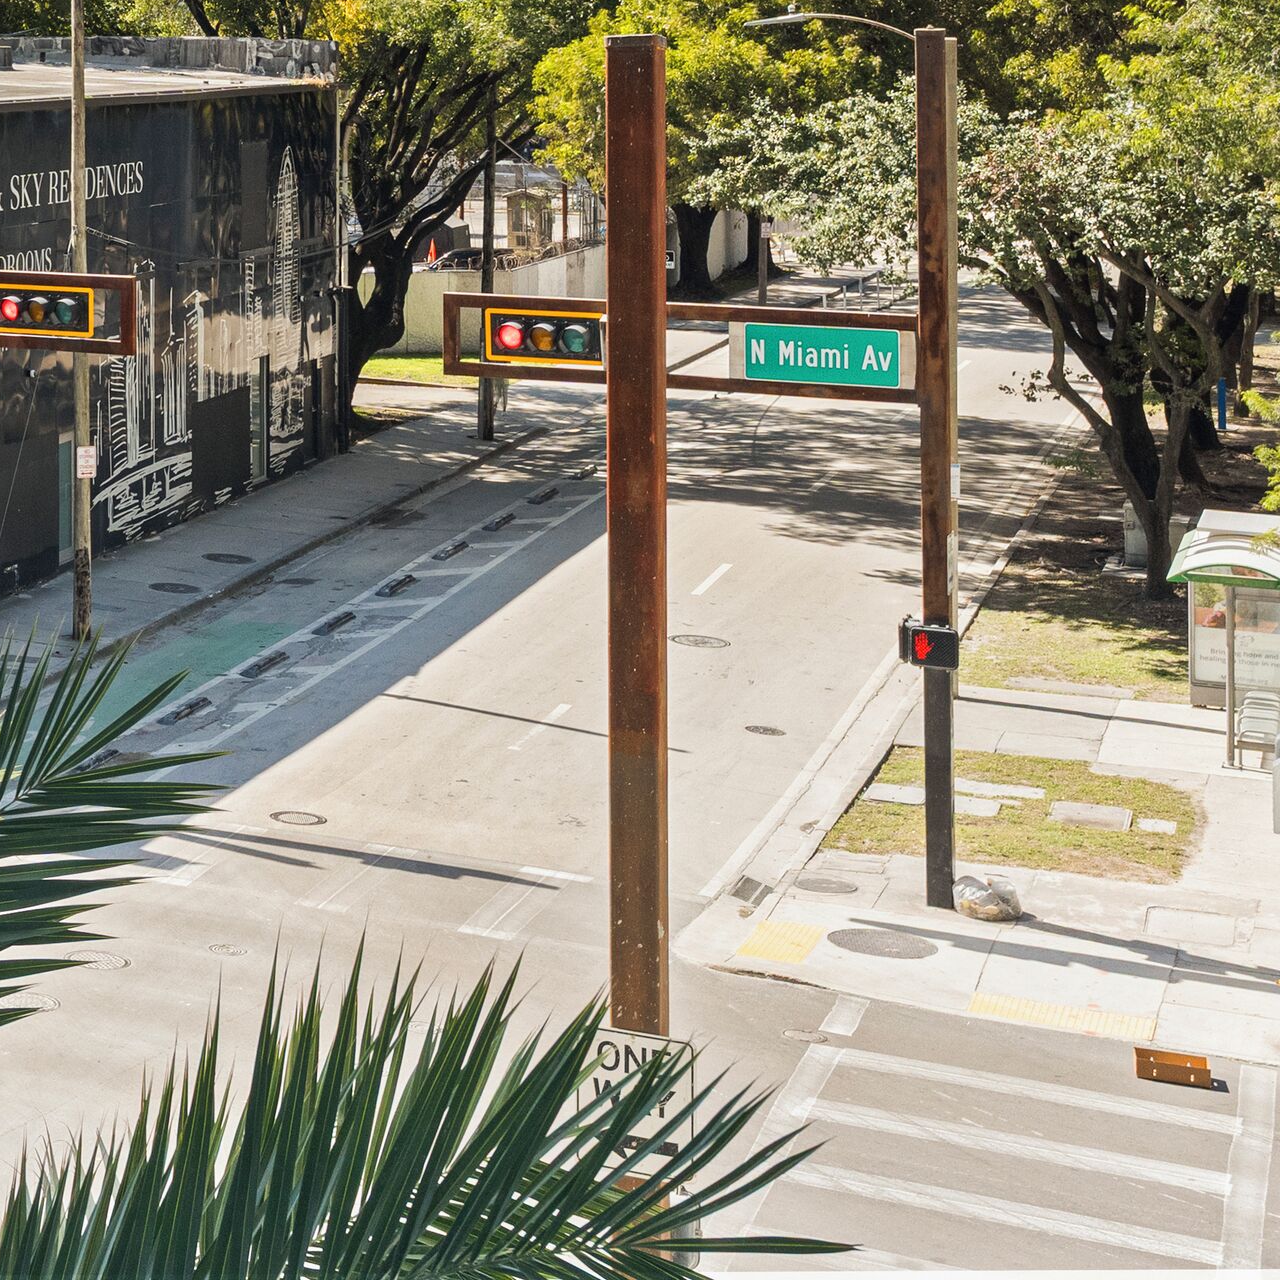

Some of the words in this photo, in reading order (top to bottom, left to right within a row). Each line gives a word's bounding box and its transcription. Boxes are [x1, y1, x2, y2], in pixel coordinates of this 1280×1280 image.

[10, 172, 45, 211] SKY
[49, 161, 144, 205] REDENCES
[751, 339, 765, 365] N
[778, 340, 849, 370] Miami
[861, 344, 893, 372] Av
[596, 1040, 672, 1074] ON
[592, 1076, 676, 1119] WY
